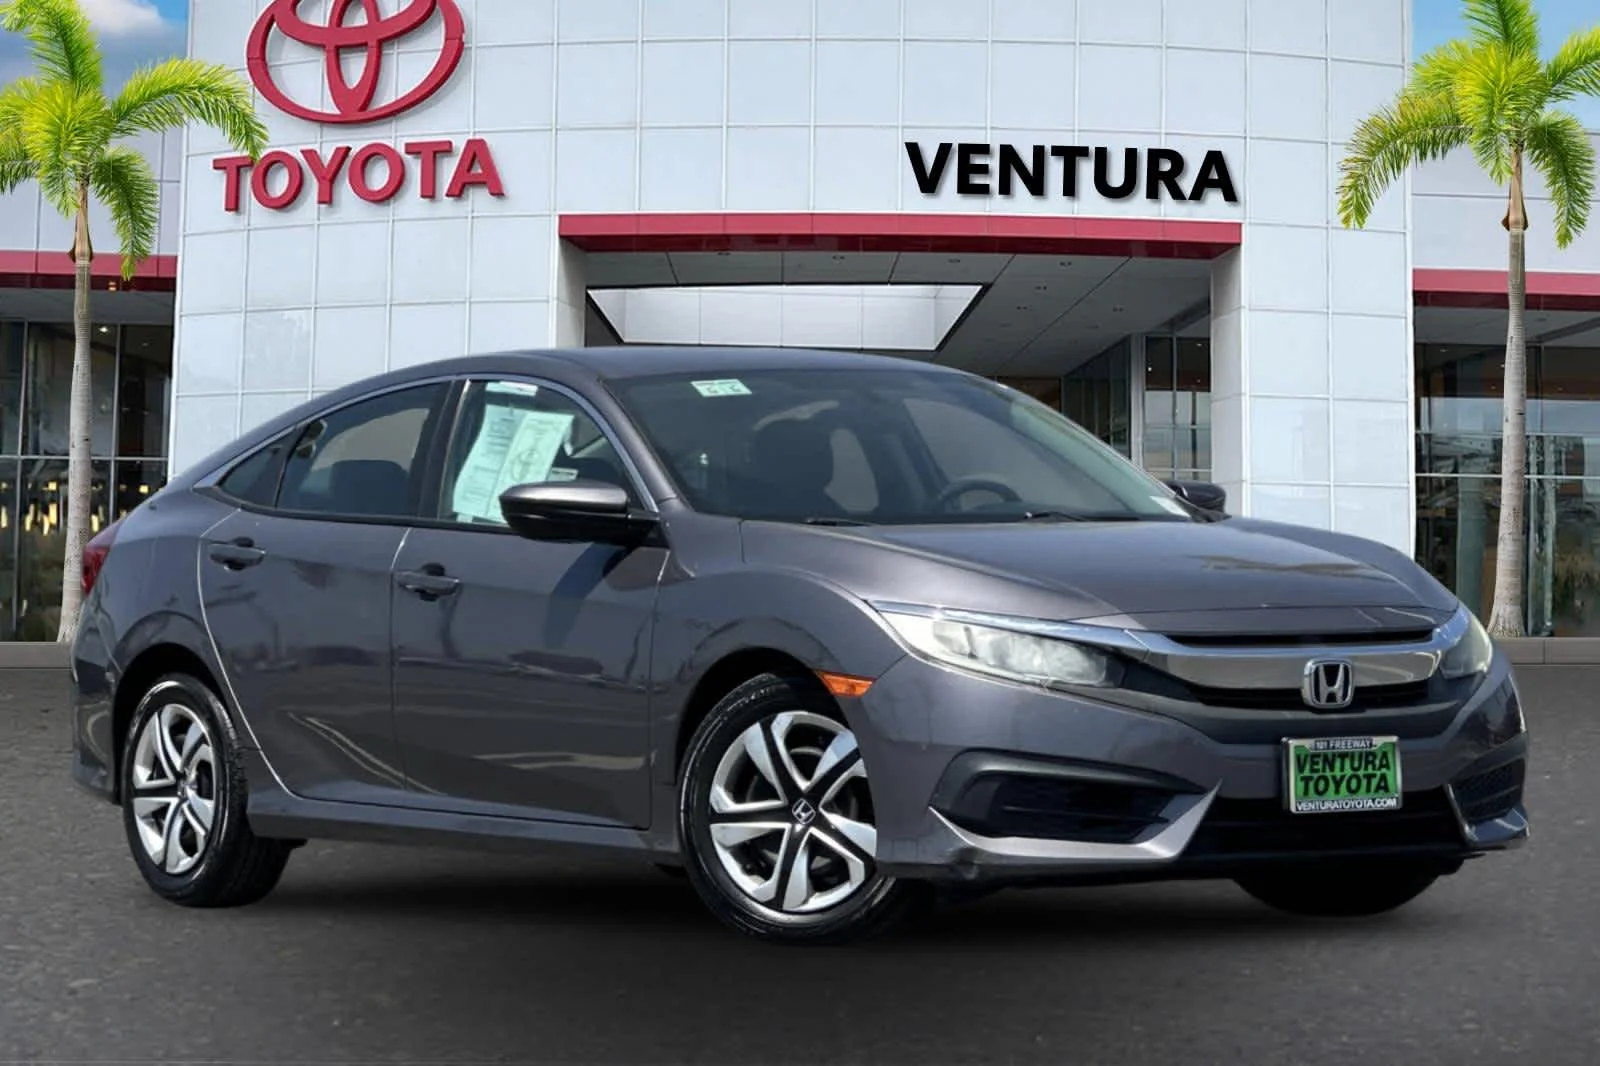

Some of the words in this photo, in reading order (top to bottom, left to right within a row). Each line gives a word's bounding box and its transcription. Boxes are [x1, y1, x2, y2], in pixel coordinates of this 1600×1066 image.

[213, 139, 505, 213] TOYOTA
[905, 141, 1238, 203] VENTURA
[1329, 739, 1371, 749] FREEWAY
[1296, 751, 1391, 773] VENTURA
[1300, 773, 1390, 796] TOYOTA
[1297, 798, 1397, 811] VENTURATOYOTA.COM
